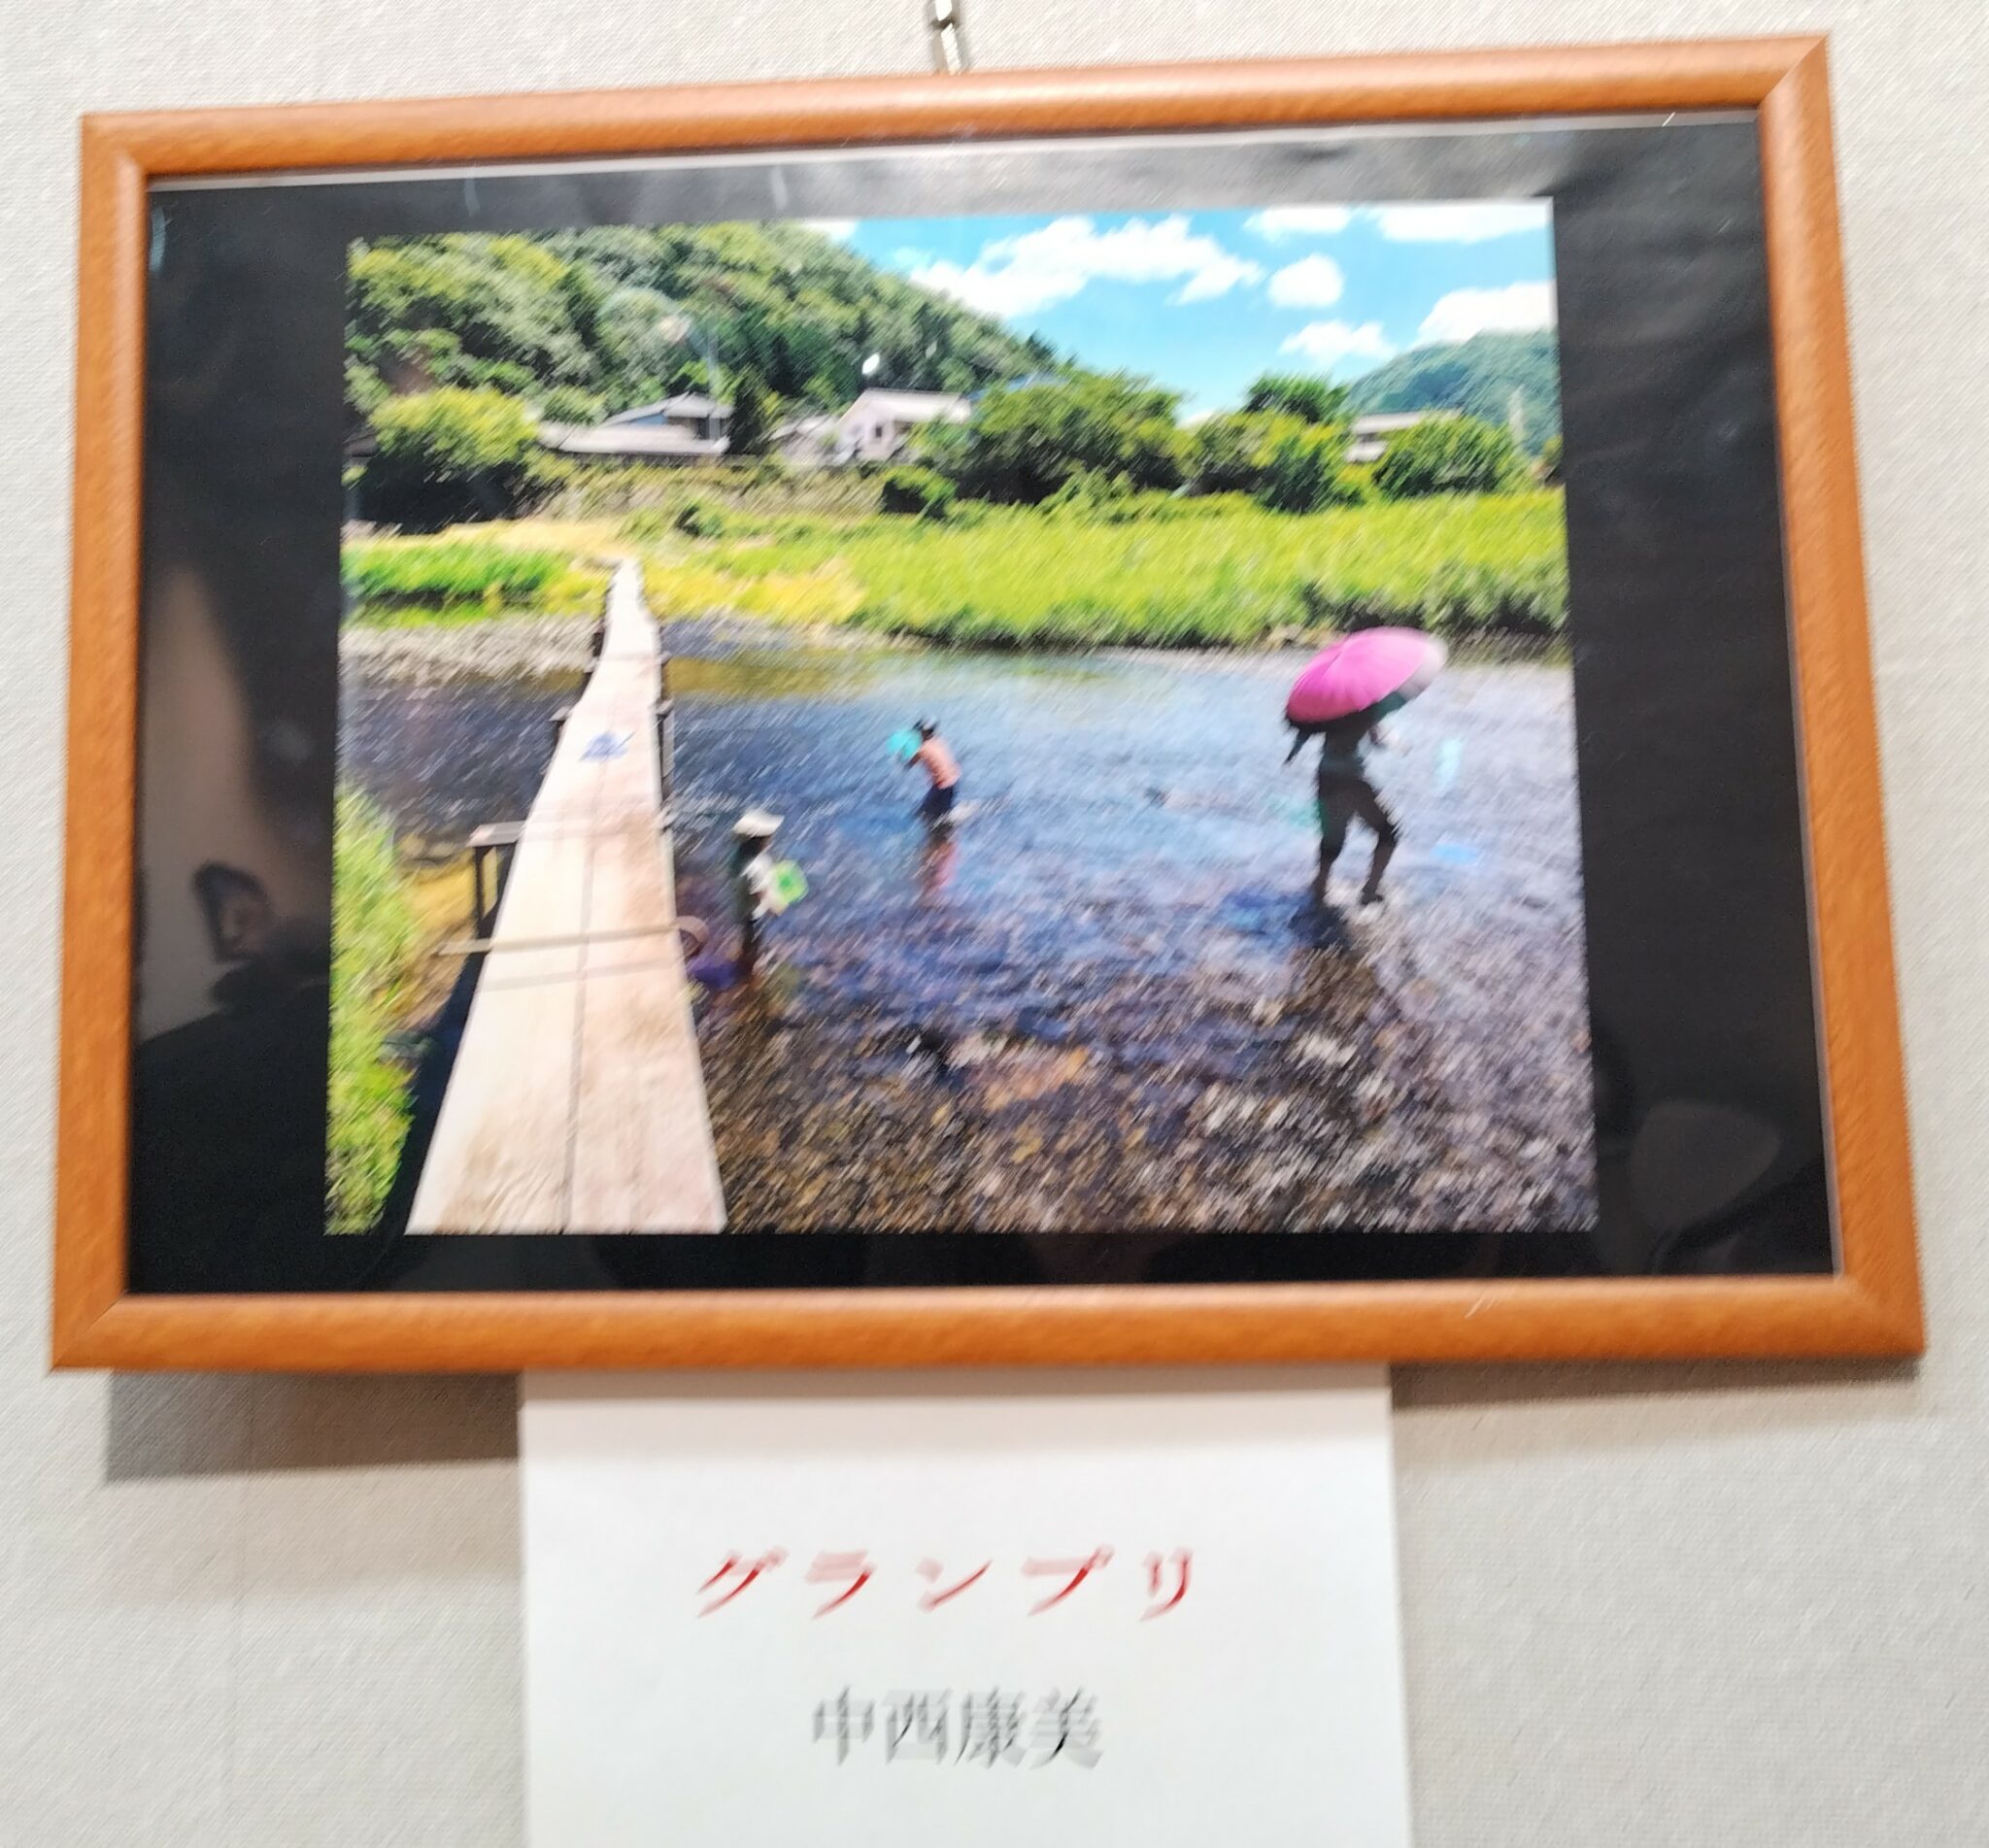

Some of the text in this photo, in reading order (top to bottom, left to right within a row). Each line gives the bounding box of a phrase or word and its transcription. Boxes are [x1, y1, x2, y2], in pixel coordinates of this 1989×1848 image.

[696, 1545, 1195, 1621] グランプリ
[812, 1685, 1104, 1769] 中西康美
